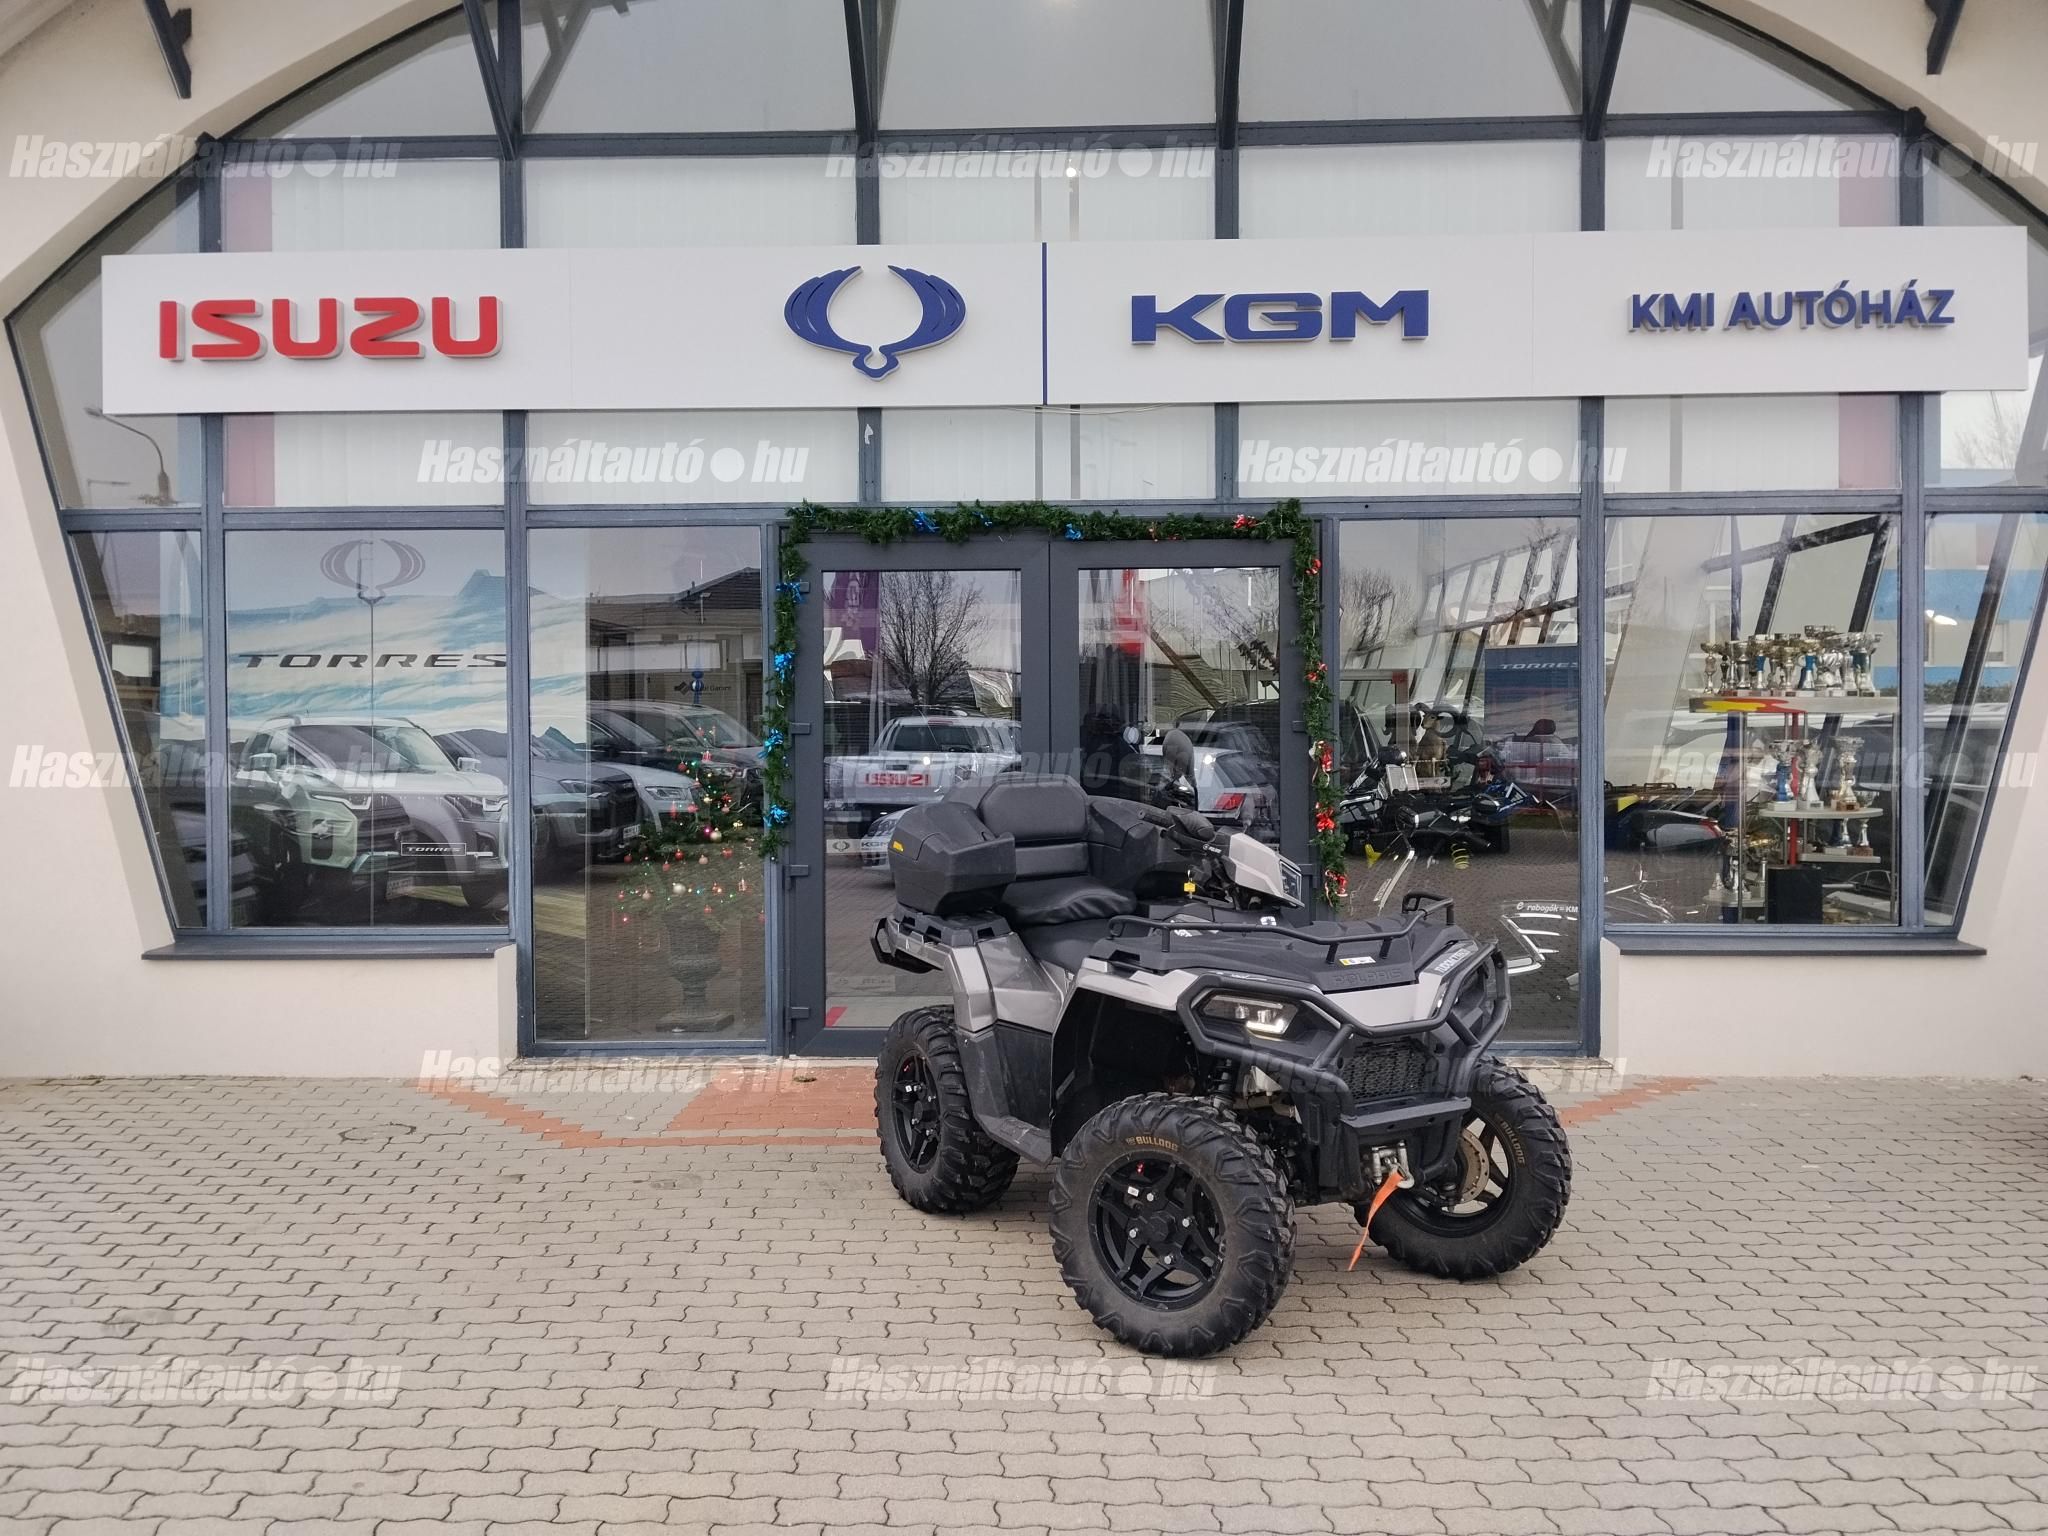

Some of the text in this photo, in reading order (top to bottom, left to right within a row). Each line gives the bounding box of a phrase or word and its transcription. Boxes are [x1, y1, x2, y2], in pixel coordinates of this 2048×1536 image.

[159, 296, 500, 360] ISUZU
[1131, 289, 1430, 345] KGM
[1629, 279, 1956, 331] KMI AUTÓHÁZ
[238, 653, 507, 668] TORRES
